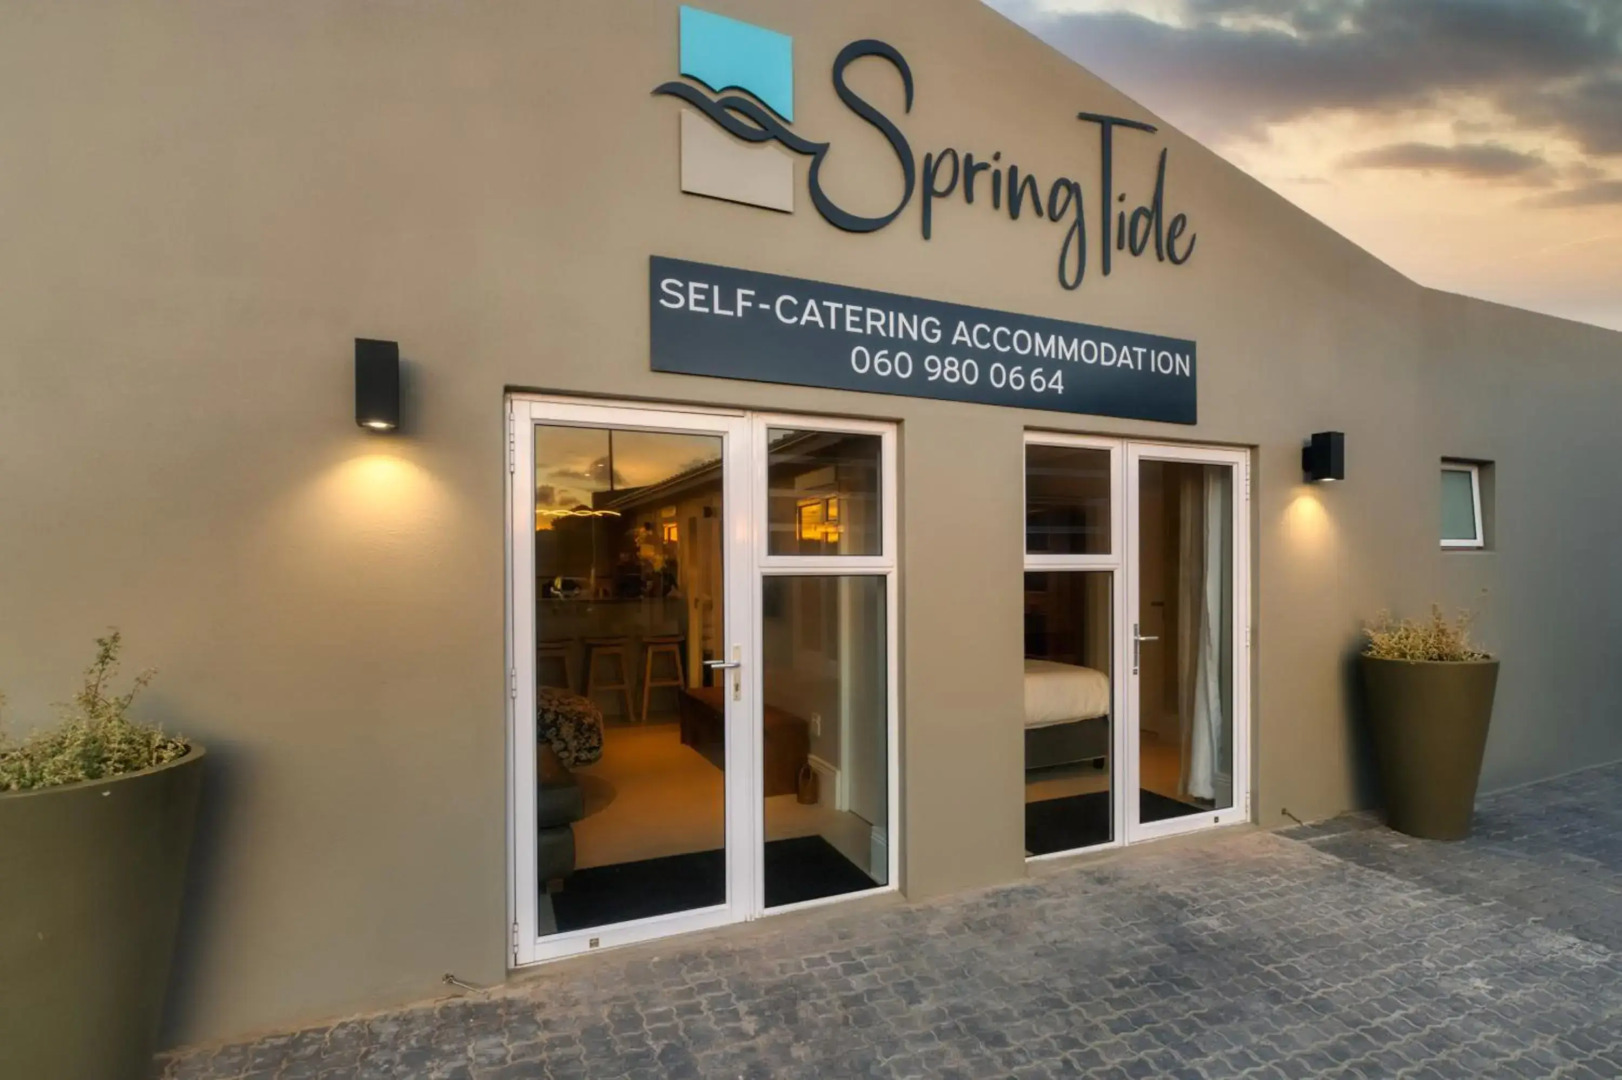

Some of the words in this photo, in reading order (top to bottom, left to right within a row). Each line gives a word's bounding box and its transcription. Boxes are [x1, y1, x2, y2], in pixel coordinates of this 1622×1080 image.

[659, 278, 942, 344] SELF-CATERING
[951, 320, 1191, 378] ACCOMMODATION
[850, 345, 913, 379] 060
[923, 354, 980, 386] 980
[989, 362, 1065, 395] 0664
